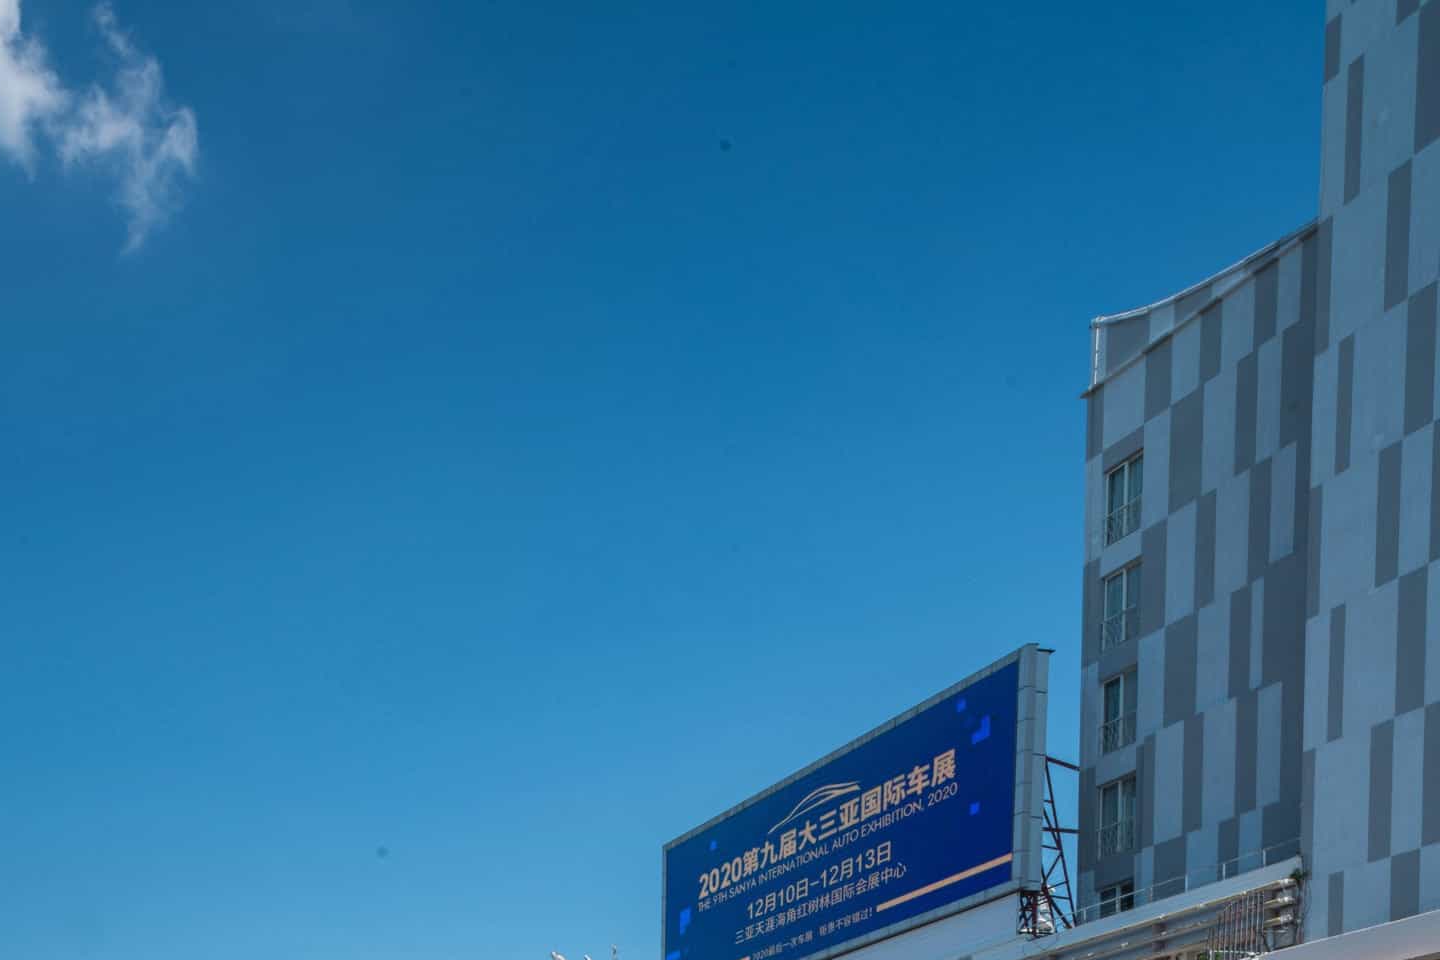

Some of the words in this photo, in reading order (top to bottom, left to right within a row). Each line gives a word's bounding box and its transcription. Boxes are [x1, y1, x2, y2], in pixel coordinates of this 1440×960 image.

[698, 749, 956, 899] 2020第九届大三亚国际车展
[729, 880, 756, 899] SANYA
[758, 843, 829, 885] INTERNATIONAL
[832, 829, 859, 851] AUTO
[928, 782, 958, 807] 2020
[735, 862, 907, 944] 三亚天涯海角红树林国际会展中心
